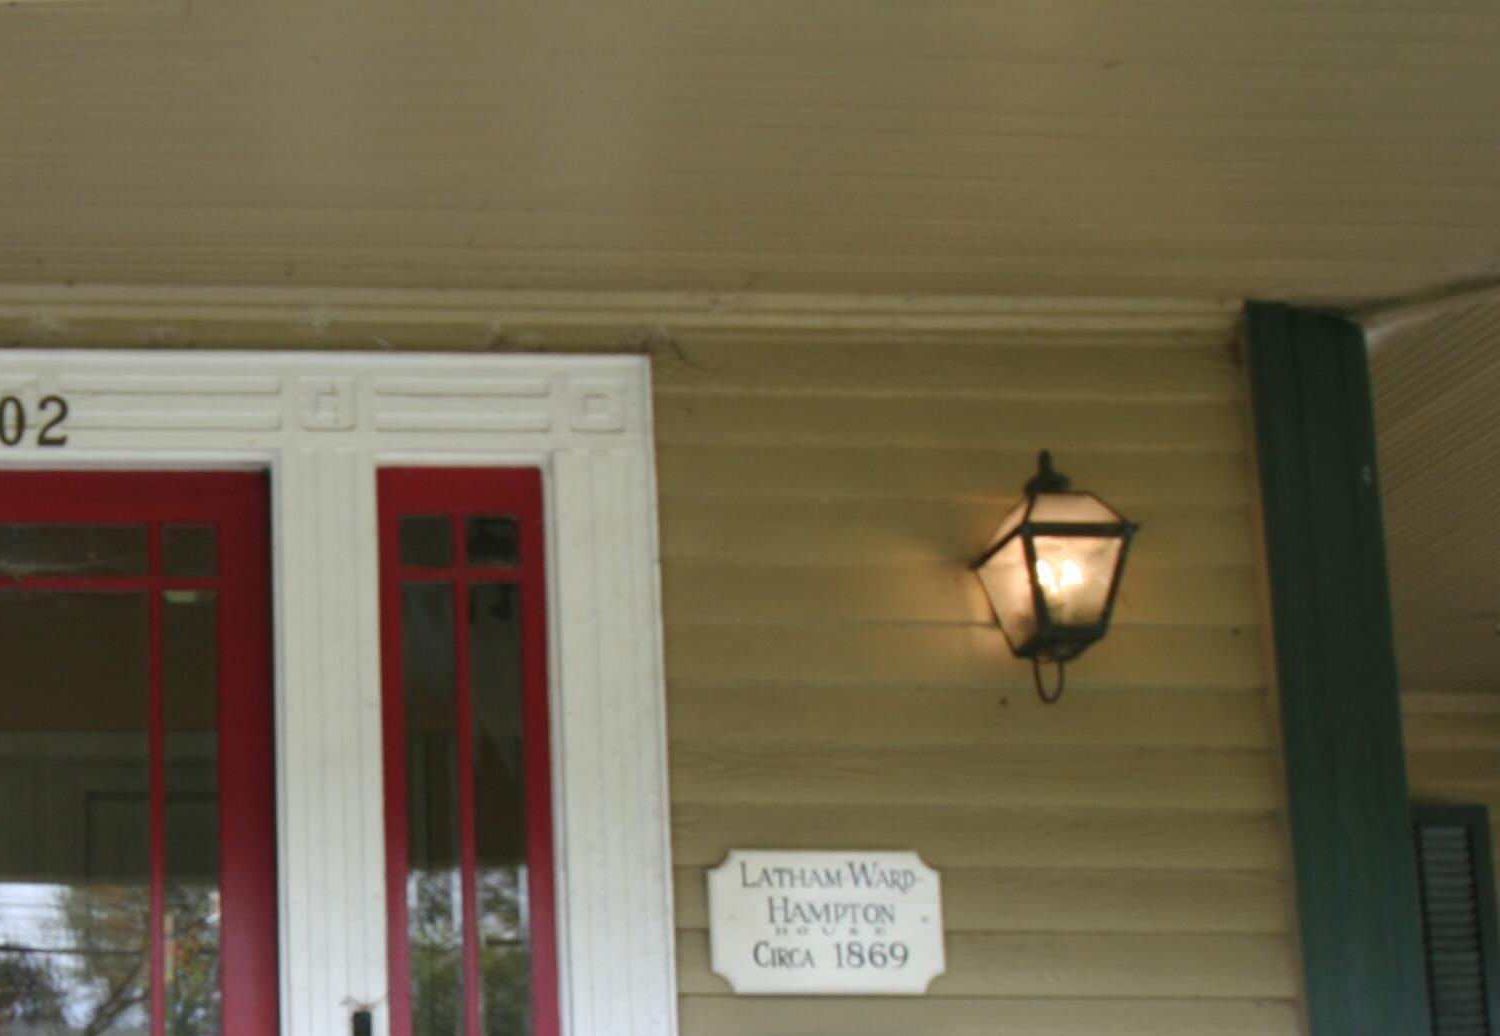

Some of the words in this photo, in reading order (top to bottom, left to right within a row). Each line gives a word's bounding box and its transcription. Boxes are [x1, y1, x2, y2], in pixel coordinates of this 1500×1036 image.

[767, 896, 895, 924] HAMPTON
[753, 940, 816, 969] CIRCA
[835, 941, 910, 969] 1869
